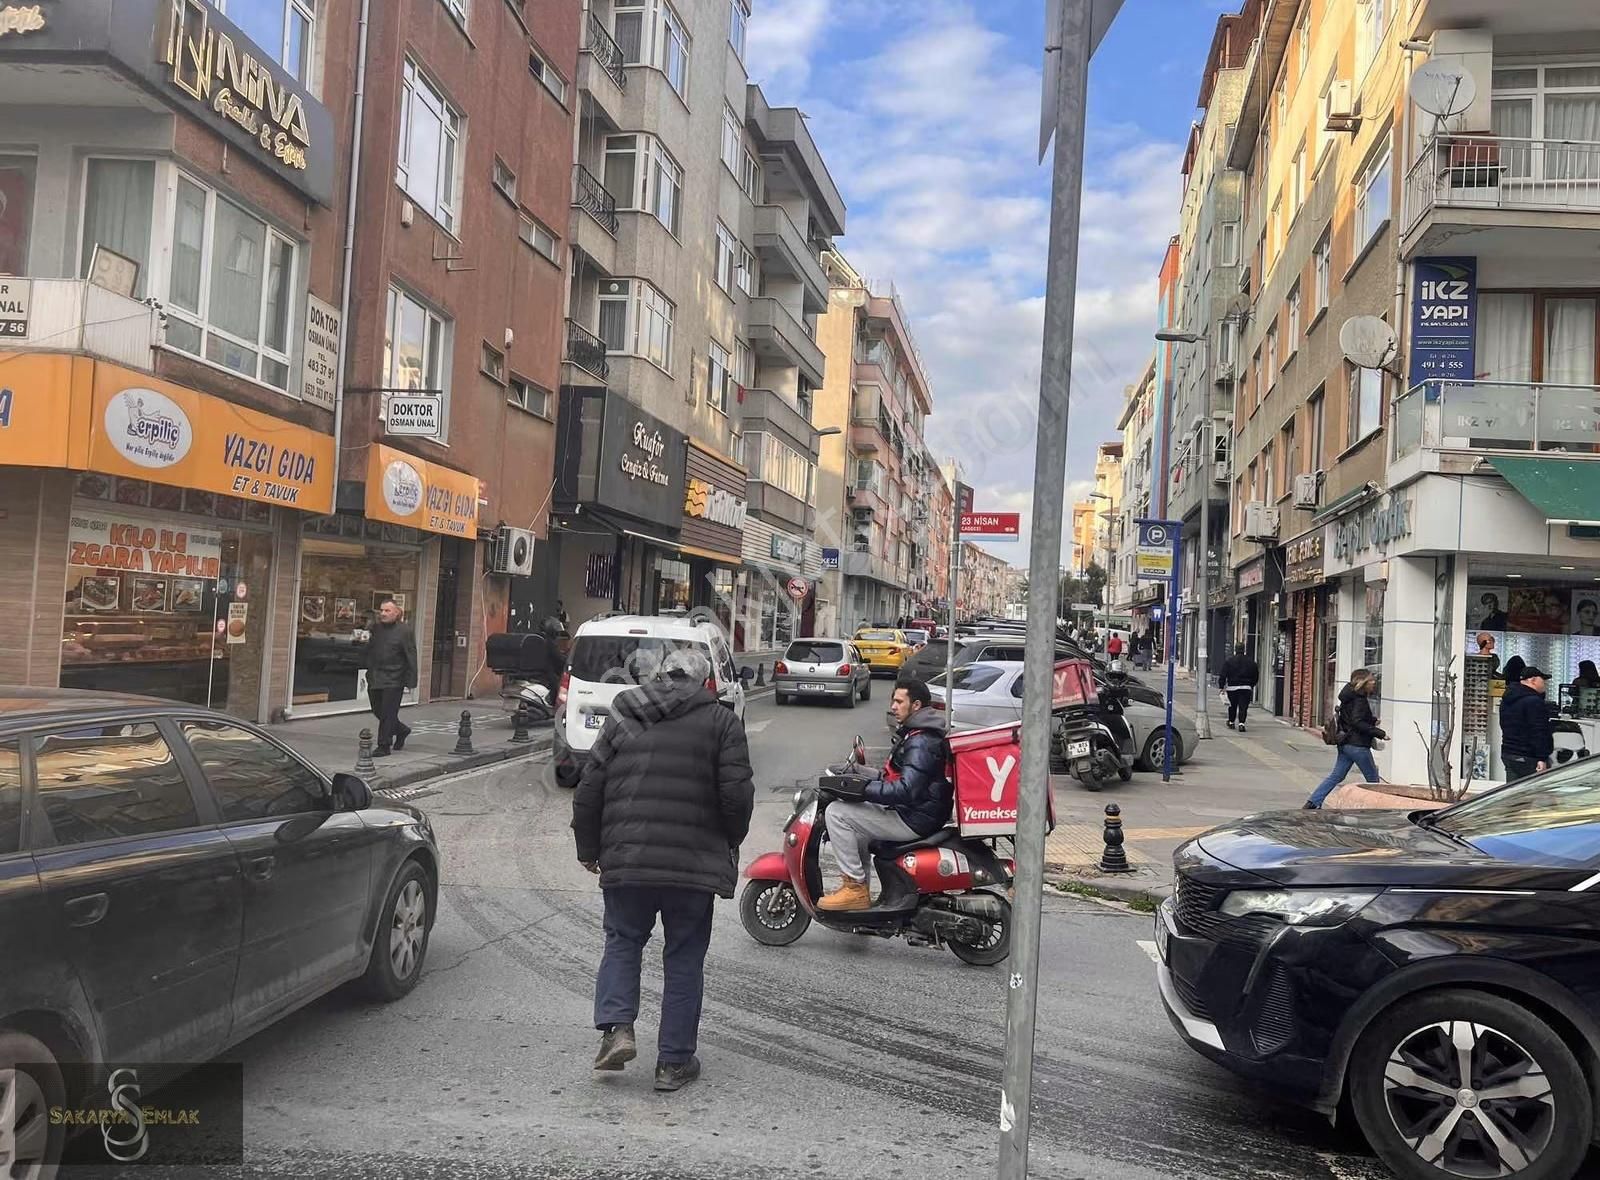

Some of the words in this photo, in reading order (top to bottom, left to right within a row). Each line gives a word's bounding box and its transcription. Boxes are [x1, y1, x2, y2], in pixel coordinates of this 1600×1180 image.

[1420, 305, 1469, 320] YAPI
[9, 323, 25, 332] 56
[310, 306, 339, 337] DOKTOR
[308, 329, 325, 349] OSMAN
[1421, 361, 1435, 369] 491
[1440, 361, 1446, 369] 4
[1448, 361, 1464, 369] 555
[393, 403, 433, 417] DOKTOR
[390, 417, 415, 427] OSMAN
[223, 432, 275, 474] YAZGI
[277, 448, 315, 484] GIDA
[232, 475, 251, 492] ET
[251, 479, 260, 495] &
[263, 481, 299, 503] TAVUK
[426, 484, 453, 514] YAZGI
[455, 492, 476, 519] GIDA
[961, 516, 971, 525] 23
[973, 514, 999, 526] NİSAN
[70, 541, 144, 571] ZGARA
[985, 754, 1016, 802] Y
[963, 806, 1017, 821] Yemekse
